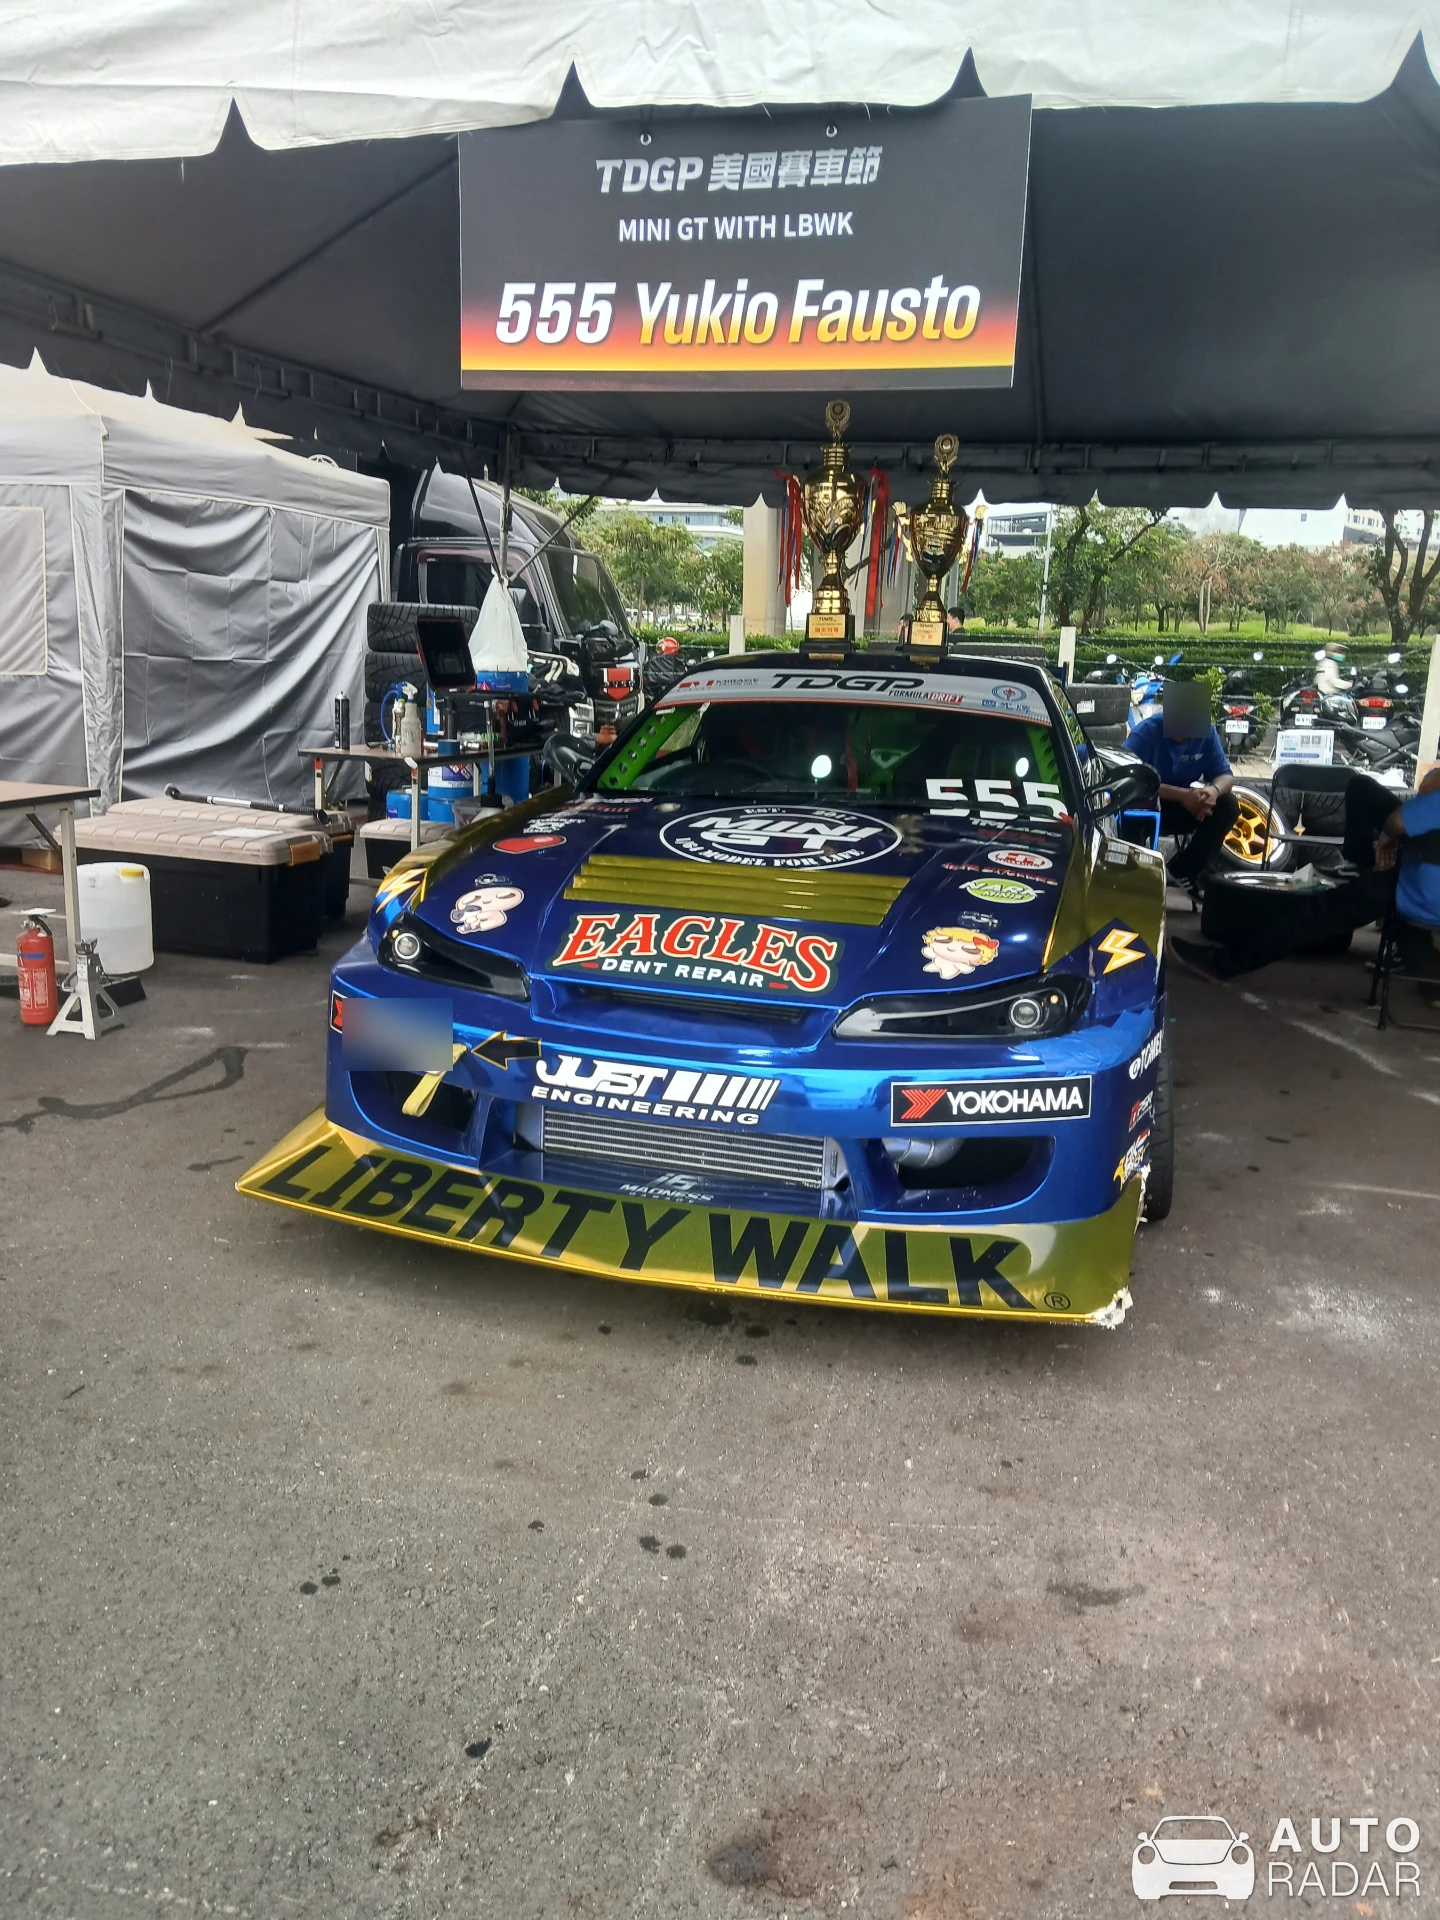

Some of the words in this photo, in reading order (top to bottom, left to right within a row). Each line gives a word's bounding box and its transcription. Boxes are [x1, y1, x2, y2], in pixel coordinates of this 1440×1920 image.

[596, 155, 703, 194] TDGP
[707, 145, 883, 192] 美國賽車節
[618, 217, 670, 242] MINI
[677, 216, 708, 241] GT
[714, 214, 776, 240] WITH
[783, 211, 854, 237] LBWK
[495, 280, 617, 345] 555
[636, 277, 779, 345] Yukio
[787, 273, 981, 343] Fausto
[771, 673, 925, 692] TDGP
[888, 689, 930, 699] FORMULA
[928, 692, 965, 704] DRIFT
[925, 778, 1069, 823] 555
[689, 816, 884, 841] MINI
[700, 829, 863, 850] GT
[698, 849, 767, 867] MODEL
[773, 857, 818, 867] FOR
[552, 913, 838, 992] EAGLES
[601, 958, 668, 976] DENT
[674, 964, 764, 988] REPAIR
[535, 1054, 669, 1098] JUST
[531, 1085, 761, 1125] ENGINEERING
[946, 1086, 1084, 1115] YOKOHAMA
[620, 1183, 714, 1201] MADNESS
[259, 1145, 692, 1271] LIBERTY
[708, 1212, 1037, 1310] WALK
